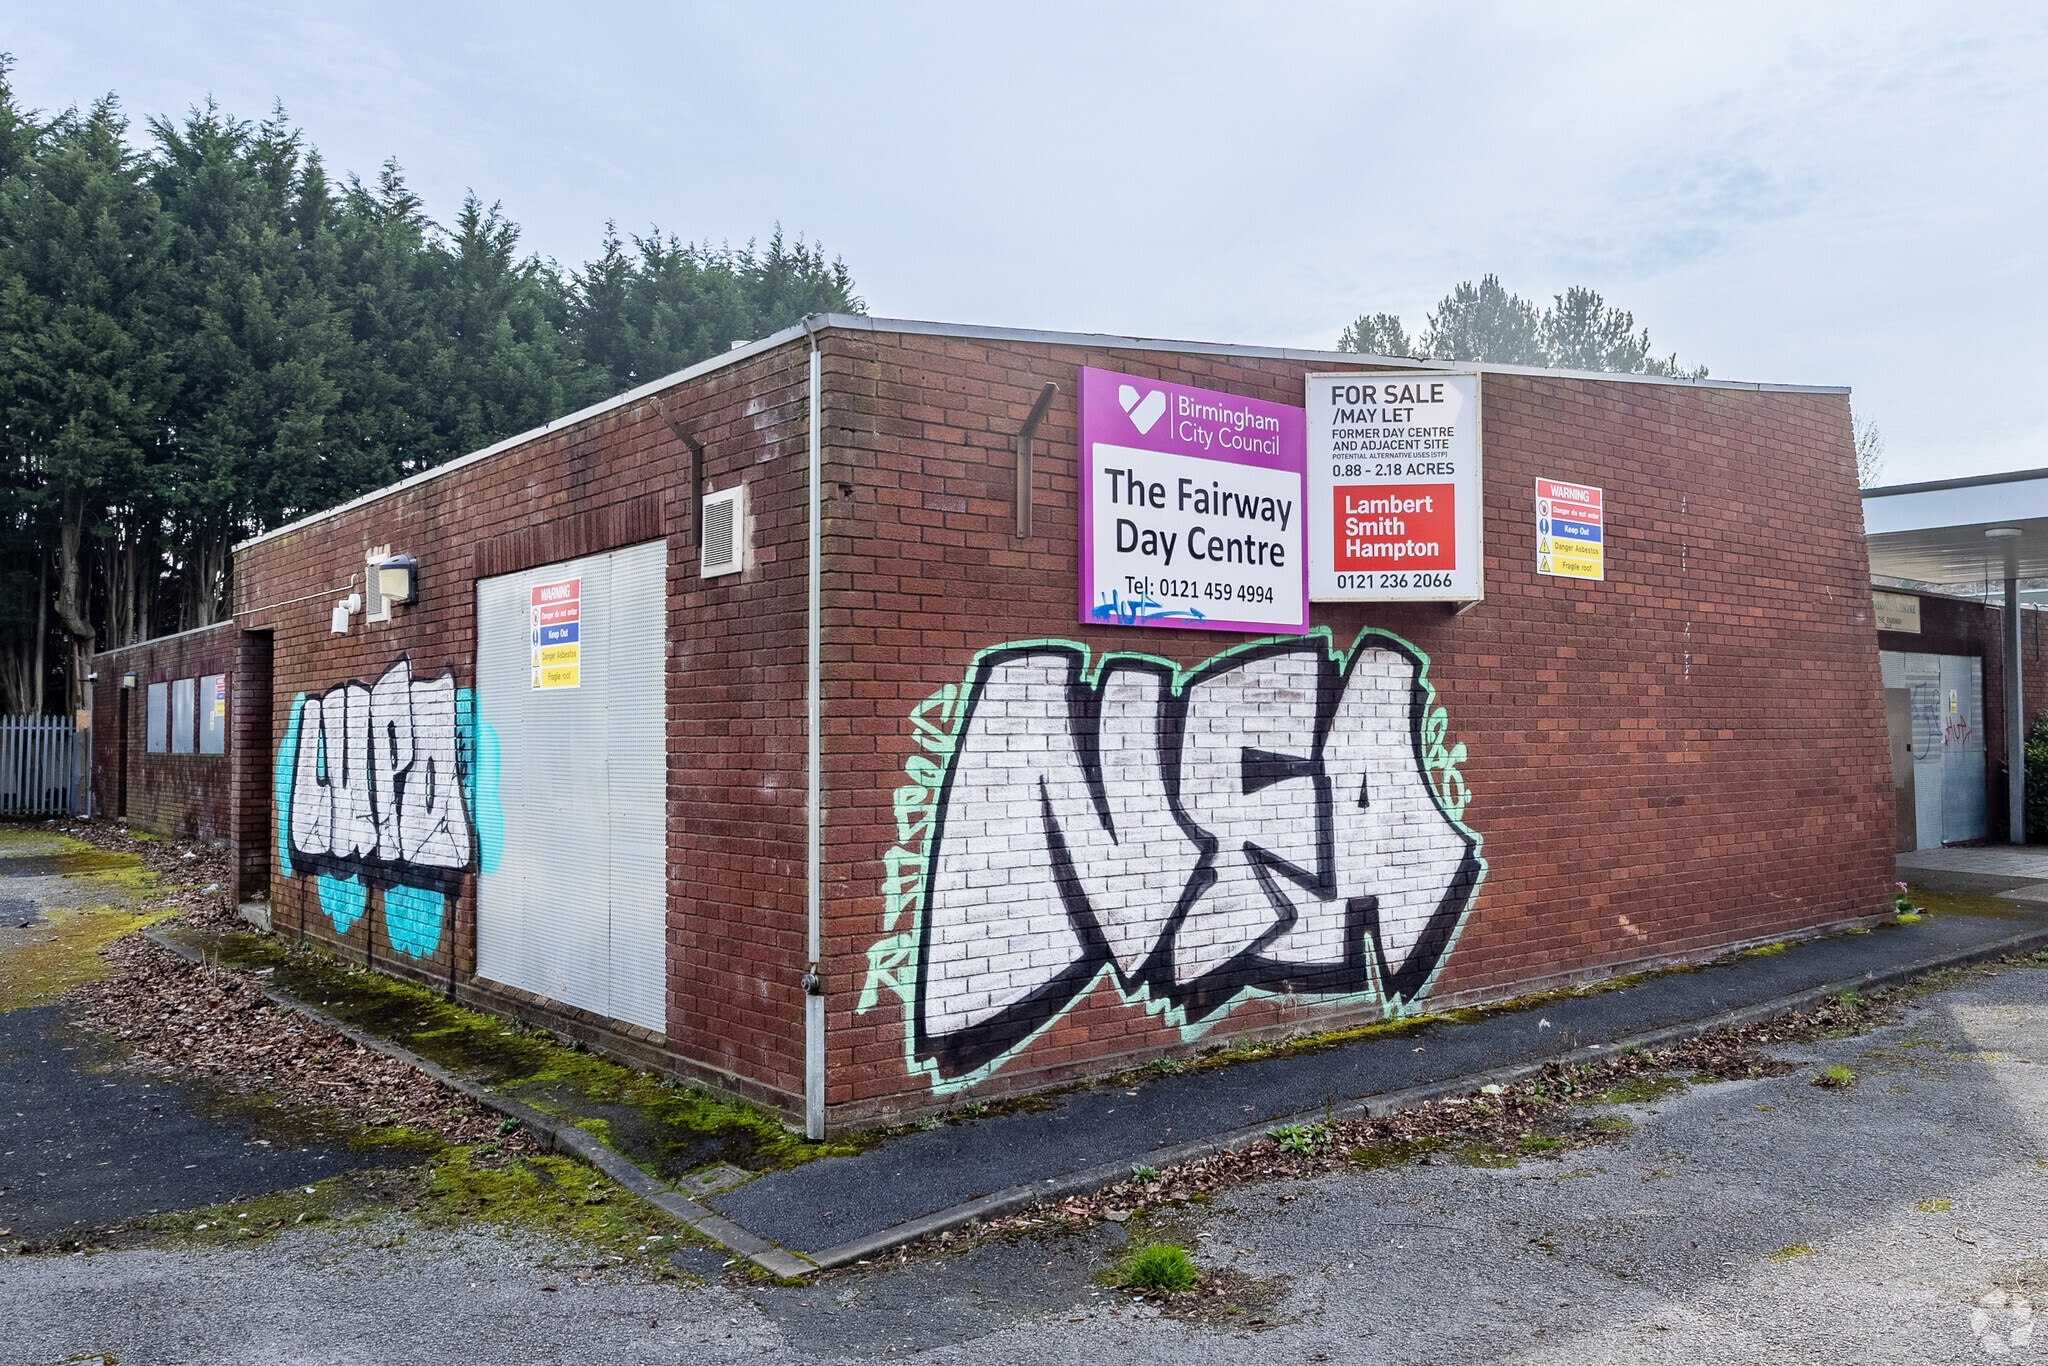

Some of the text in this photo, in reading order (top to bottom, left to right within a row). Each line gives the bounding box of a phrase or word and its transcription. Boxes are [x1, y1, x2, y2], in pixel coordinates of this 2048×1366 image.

[1332, 384, 1444, 405] FOR SALE
[1178, 396, 1279, 432] Birmingham
[1332, 408, 1414, 425] /MAY LET
[1179, 421, 1280, 455] City Council
[1332, 427, 1454, 439] FORMER DAY CENTRE
[1333, 439, 1449, 451] AND ADJACENT SITE
[1333, 464, 1361, 477] 0.88
[1375, 464, 1401, 476] 2.18
[1406, 462, 1454, 476] ACRES
[1105, 468, 1292, 531] The Fairway
[1550, 485, 1589, 502] WARNING
[1346, 494, 1433, 514] Lambert
[1553, 506, 1570, 515] Danger
[1346, 517, 1405, 536] Smith
[1564, 525, 1589, 535] Keep Out
[1116, 518, 1285, 567] Day Centre
[1346, 539, 1439, 561] Hampton
[1554, 542, 1598, 554] Danger Asbestos
[1562, 562, 1579, 570] Fragile
[1337, 573, 1452, 589] 0121 236 2066
[541, 584, 570, 602] WARNING
[1125, 576, 1274, 604] Tel: 0121 459 4994
[542, 611, 554, 620] Danger
[567, 608, 577, 616] enter
[548, 629, 568, 640] Keep Out
[542, 650, 576, 661] Danger Asbestos
[548, 671, 571, 682] Fragile roof
